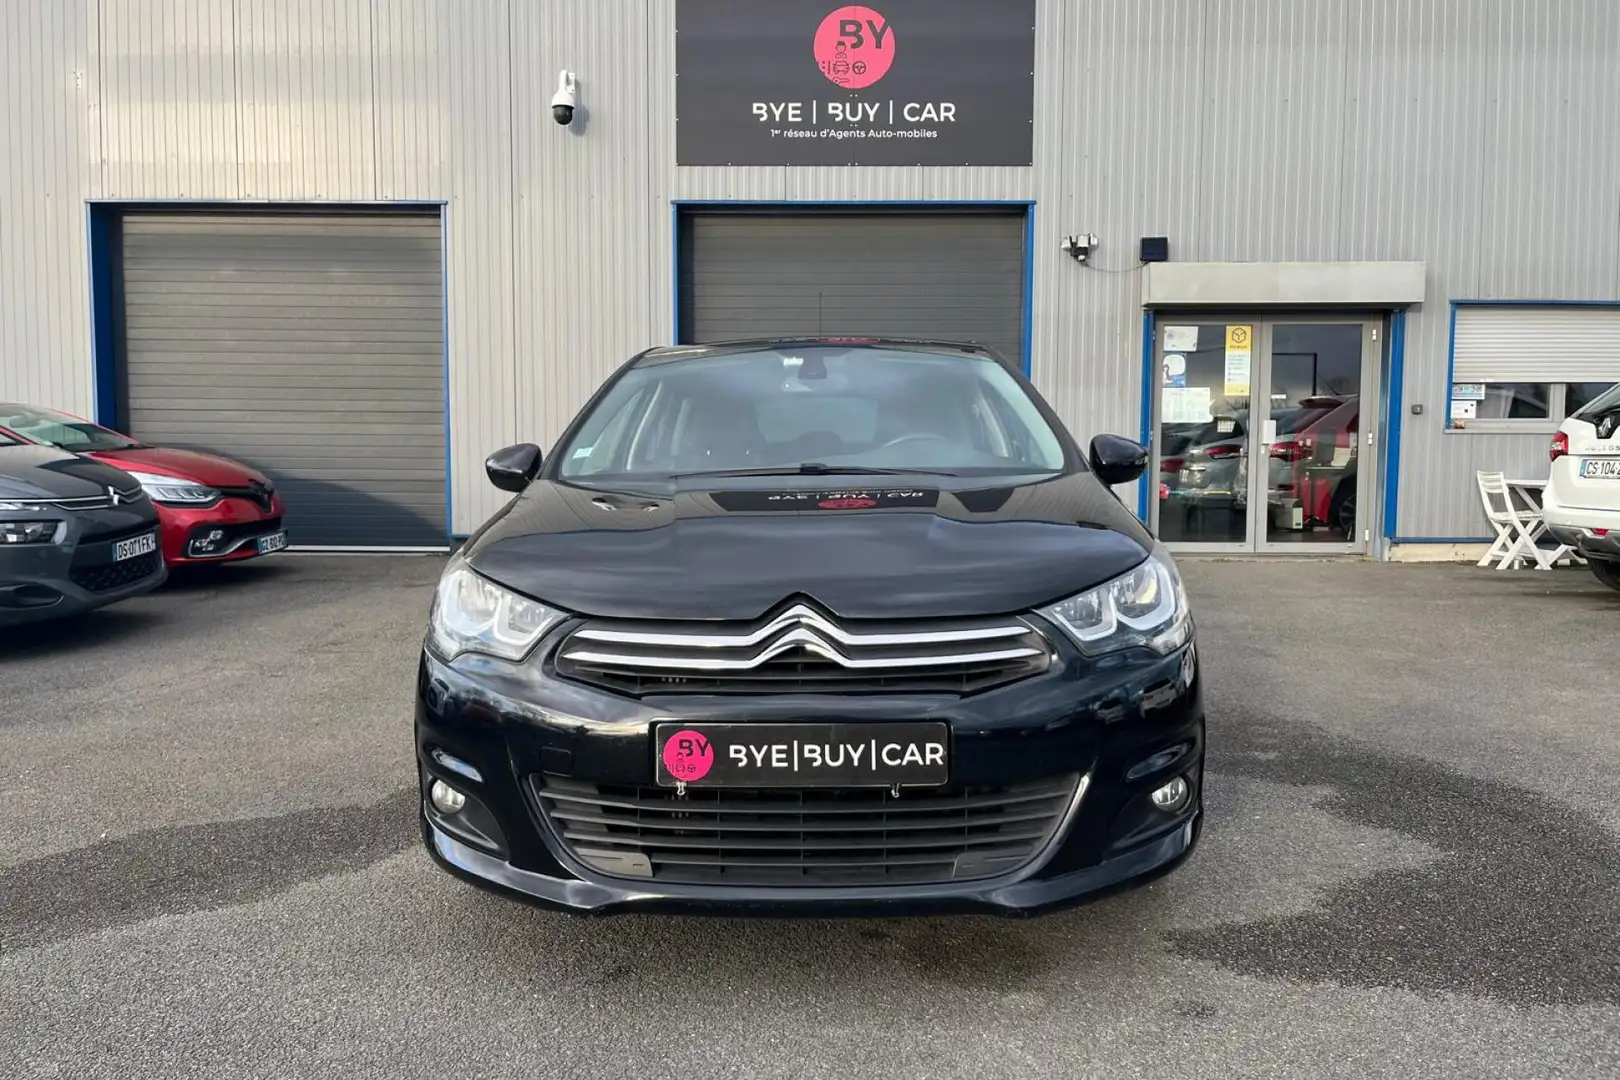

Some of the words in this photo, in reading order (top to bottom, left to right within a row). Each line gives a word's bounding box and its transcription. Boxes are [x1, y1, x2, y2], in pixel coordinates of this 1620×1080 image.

[839, 19, 888, 49] BY
[752, 102, 802, 122] BYE
[827, 102, 880, 122] BUY
[903, 102, 956, 122] CAR
[783, 128, 817, 138] réseau
[867, 128, 938, 138] Auto-mobiles
[679, 739, 710, 757] BY
